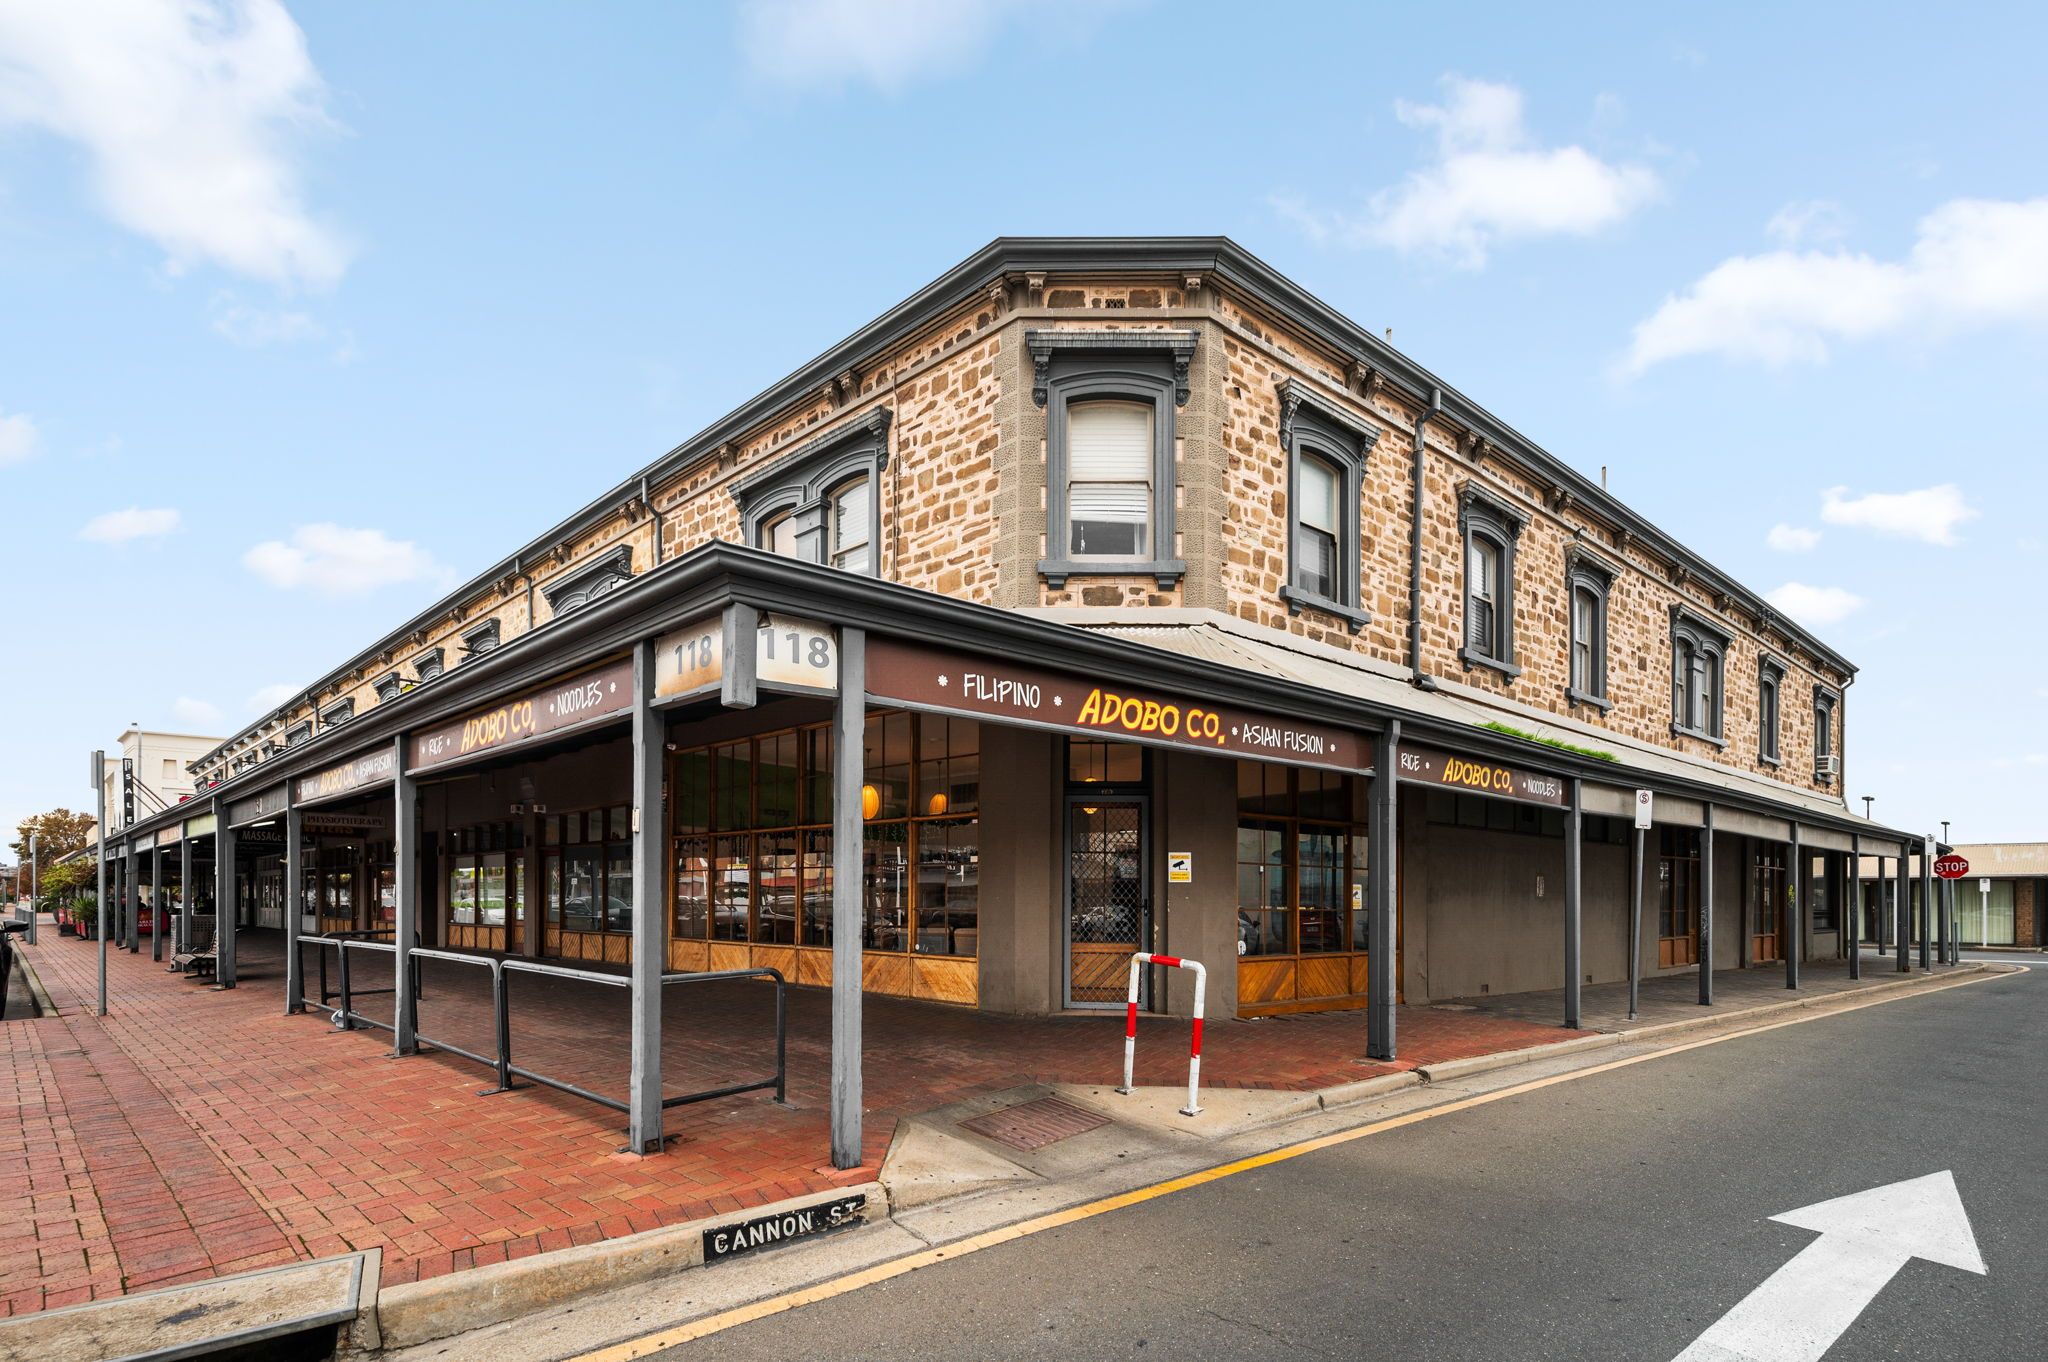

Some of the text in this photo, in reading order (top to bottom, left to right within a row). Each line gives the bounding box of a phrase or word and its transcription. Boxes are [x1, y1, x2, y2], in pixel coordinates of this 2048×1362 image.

[674, 634, 713, 675] 118
[760, 627, 829, 669] 118
[557, 679, 603, 717] NOODLES
[963, 673, 1040, 709] FILIPINO
[460, 700, 536, 753] ADOBO CO.
[1076, 687, 1225, 745] ADOBO CO.
[428, 735, 443, 757] RICE
[1242, 722, 1324, 755] ASIAN FUSION
[374, 753, 392, 774] FUSION
[1401, 752, 1421, 772] RICE
[1441, 756, 1514, 794] ADOBO CO.
[319, 768, 343, 794] ADOBO
[1527, 778, 1556, 797] NOODLES
[241, 829, 282, 842] MASSAGE
[306, 815, 384, 826] PHYSIOTHERAPY
[1935, 861, 1968, 873] STOP
[714, 1211, 813, 1254] CANNON
